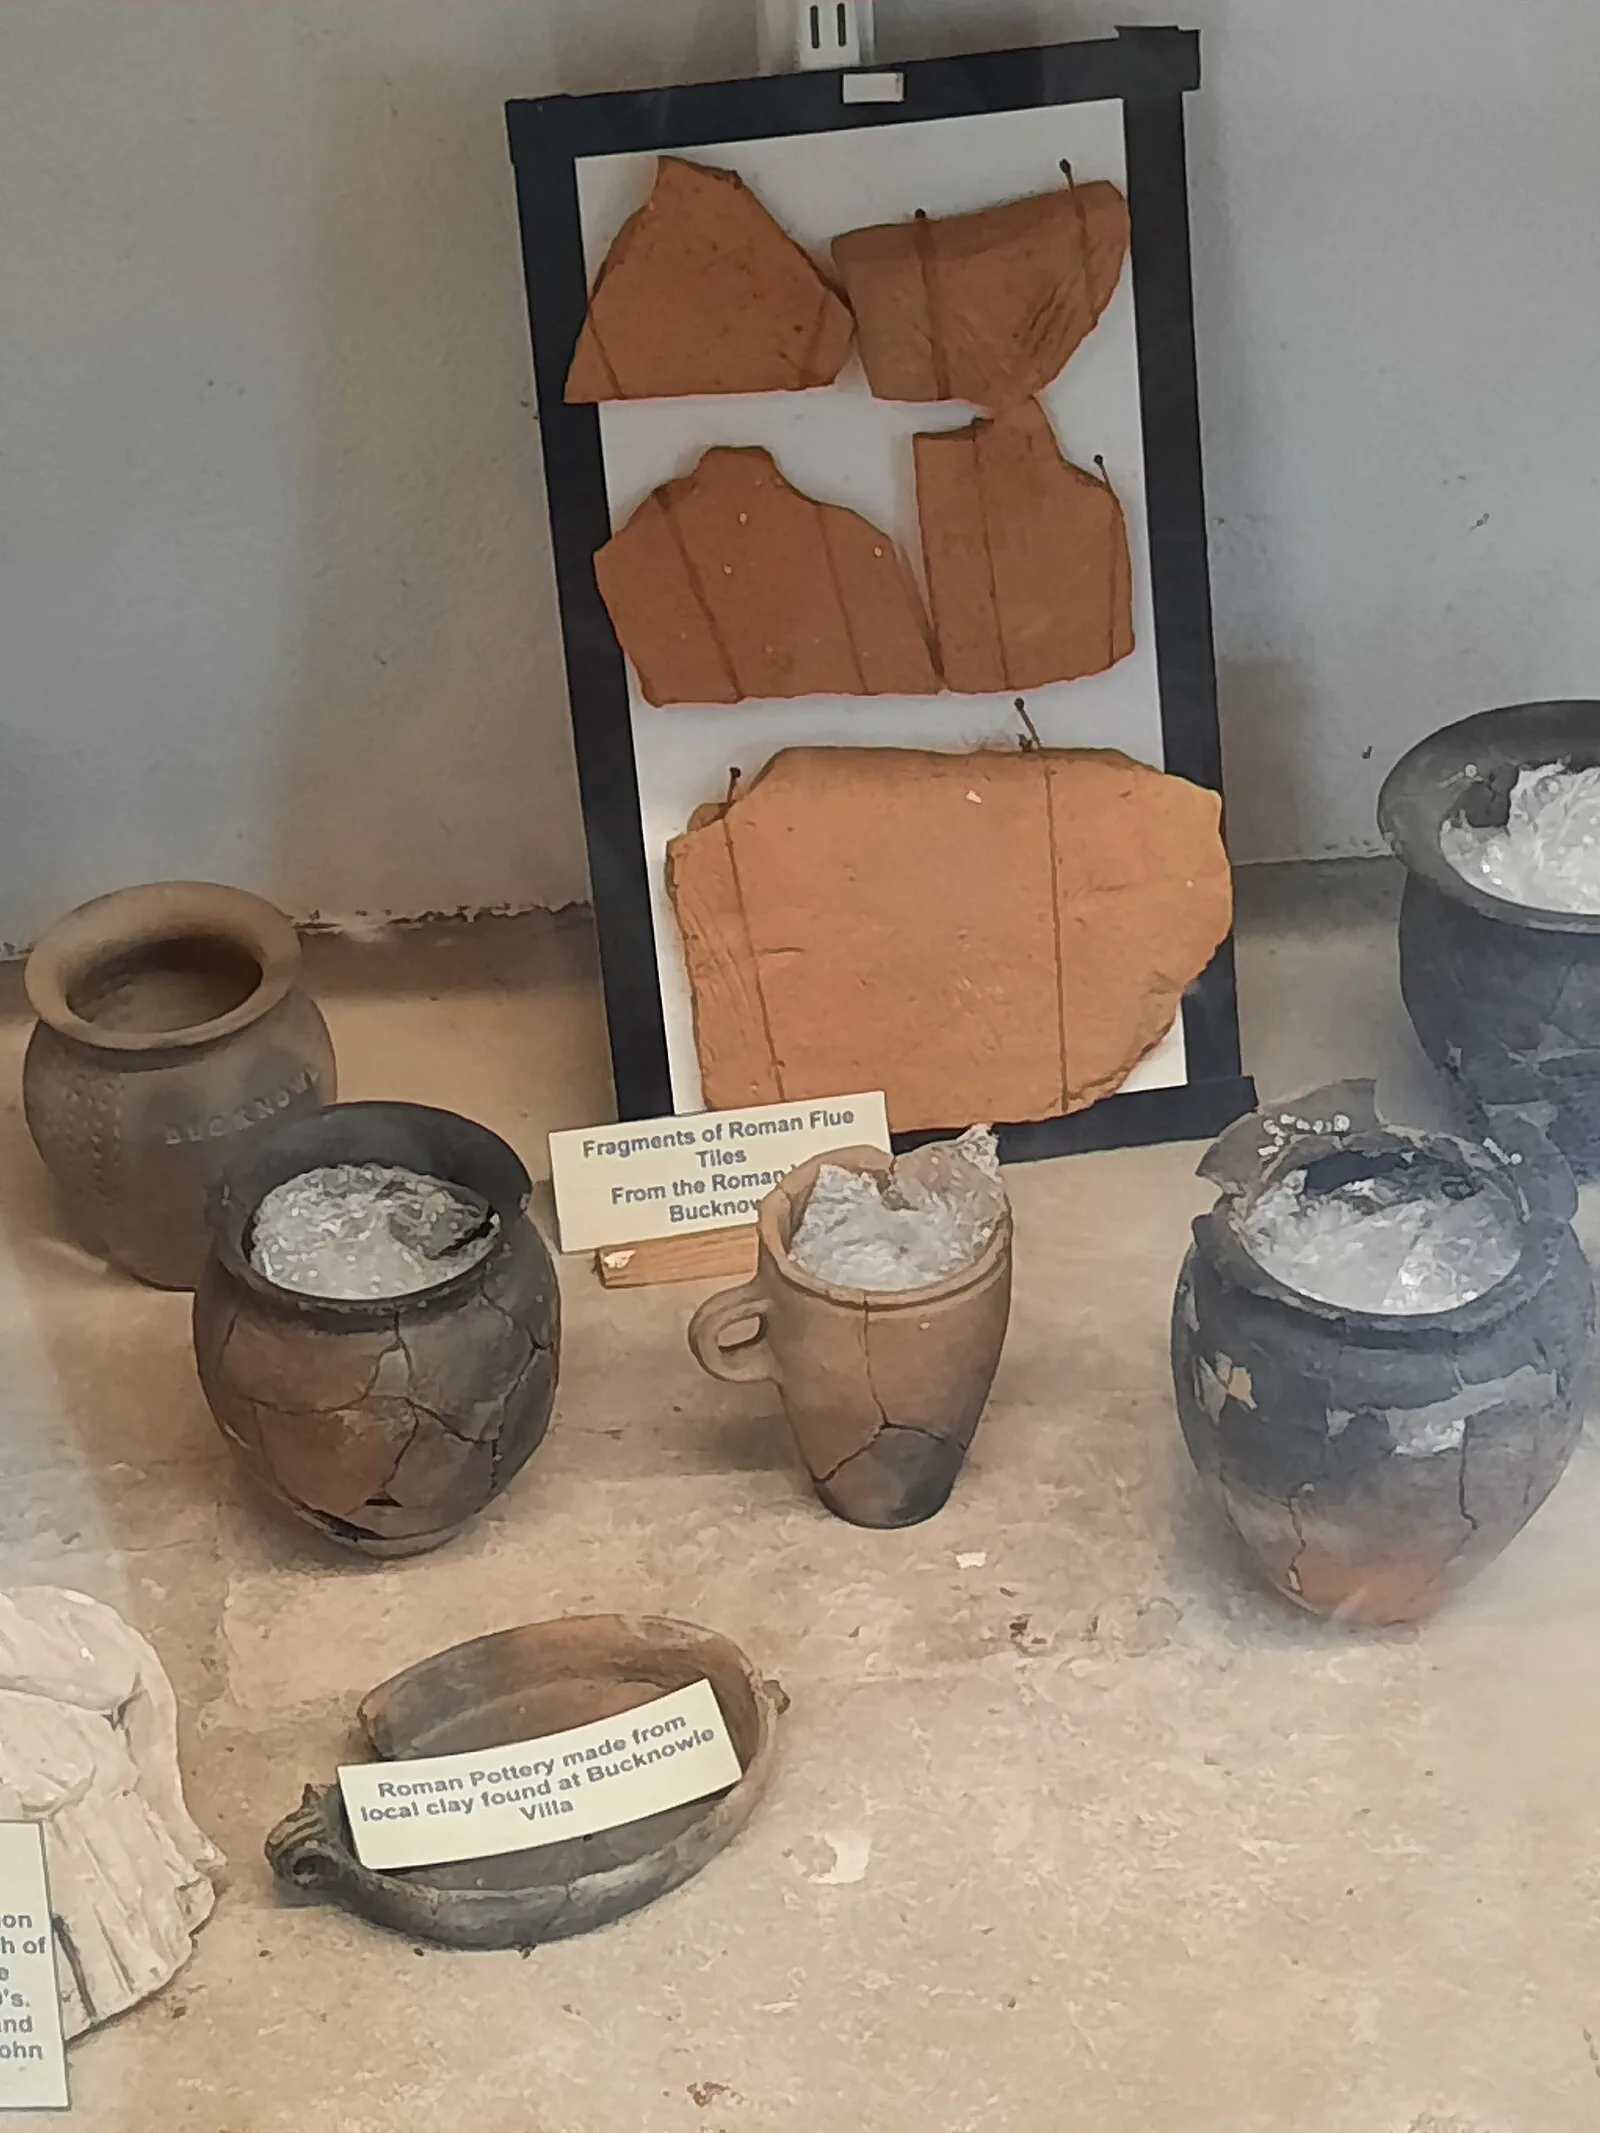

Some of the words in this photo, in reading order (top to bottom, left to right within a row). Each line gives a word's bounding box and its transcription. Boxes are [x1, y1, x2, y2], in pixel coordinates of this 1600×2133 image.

[583, 1130, 696, 1159] Fragments
[702, 1123, 724, 1143] of
[729, 1115, 803, 1138] Roman
[809, 1109, 855, 1128] Flue
[696, 1149, 747, 1169] Tiles
[611, 1184, 667, 1205] From
[672, 1178, 706, 1197] the
[711, 1169, 785, 1192] Roman
[378, 1776, 465, 1799] Roman
[469, 1757, 555, 1788] Pottery
[562, 1736, 628, 1768] made
[631, 1713, 687, 1746] from
[360, 1803, 420, 1823] local
[426, 1796, 474, 1816] clay
[481, 1779, 552, 1809] found
[558, 1773, 583, 1792] at
[586, 1727, 715, 1784] Bucknowle
[519, 1798, 575, 1822] Villa
[0, 1914, 33, 1929] on
[22, 1935, 46, 1954] of
[0, 2015, 34, 2033] nd
[0, 2041, 43, 2060] ohn
